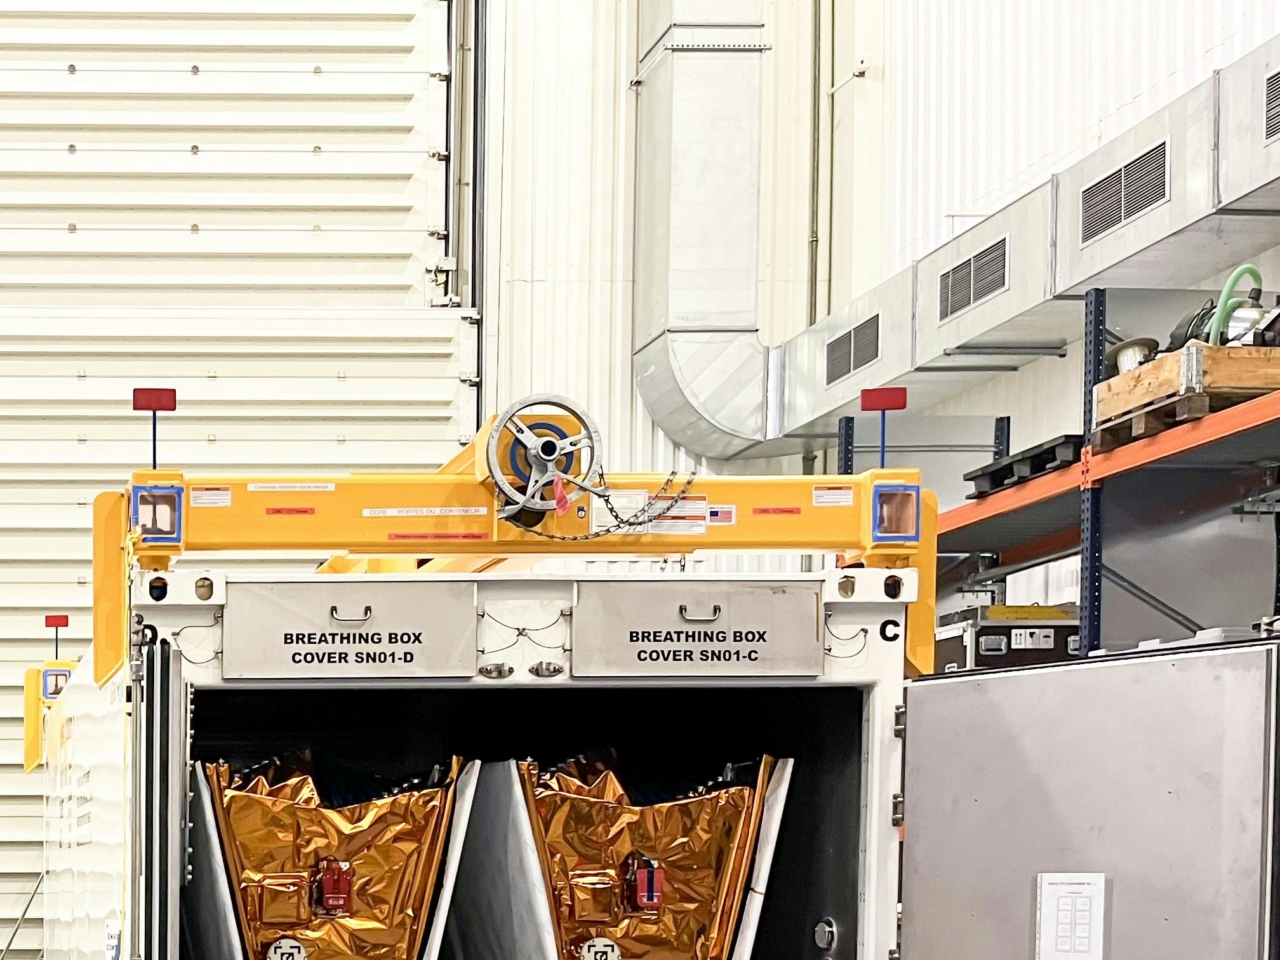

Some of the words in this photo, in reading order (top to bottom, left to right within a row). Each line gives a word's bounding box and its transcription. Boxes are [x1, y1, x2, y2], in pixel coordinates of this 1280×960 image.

[880, 620, 900, 641] C
[284, 633, 382, 644] BREATHING
[389, 633, 422, 644] BOX
[630, 631, 726, 642] BREATHING
[733, 631, 767, 642] BOX
[292, 652, 348, 663] COVER
[355, 652, 413, 663] SN01-D
[637, 650, 694, 661] COVER
[700, 650, 758, 661] SN01-C
